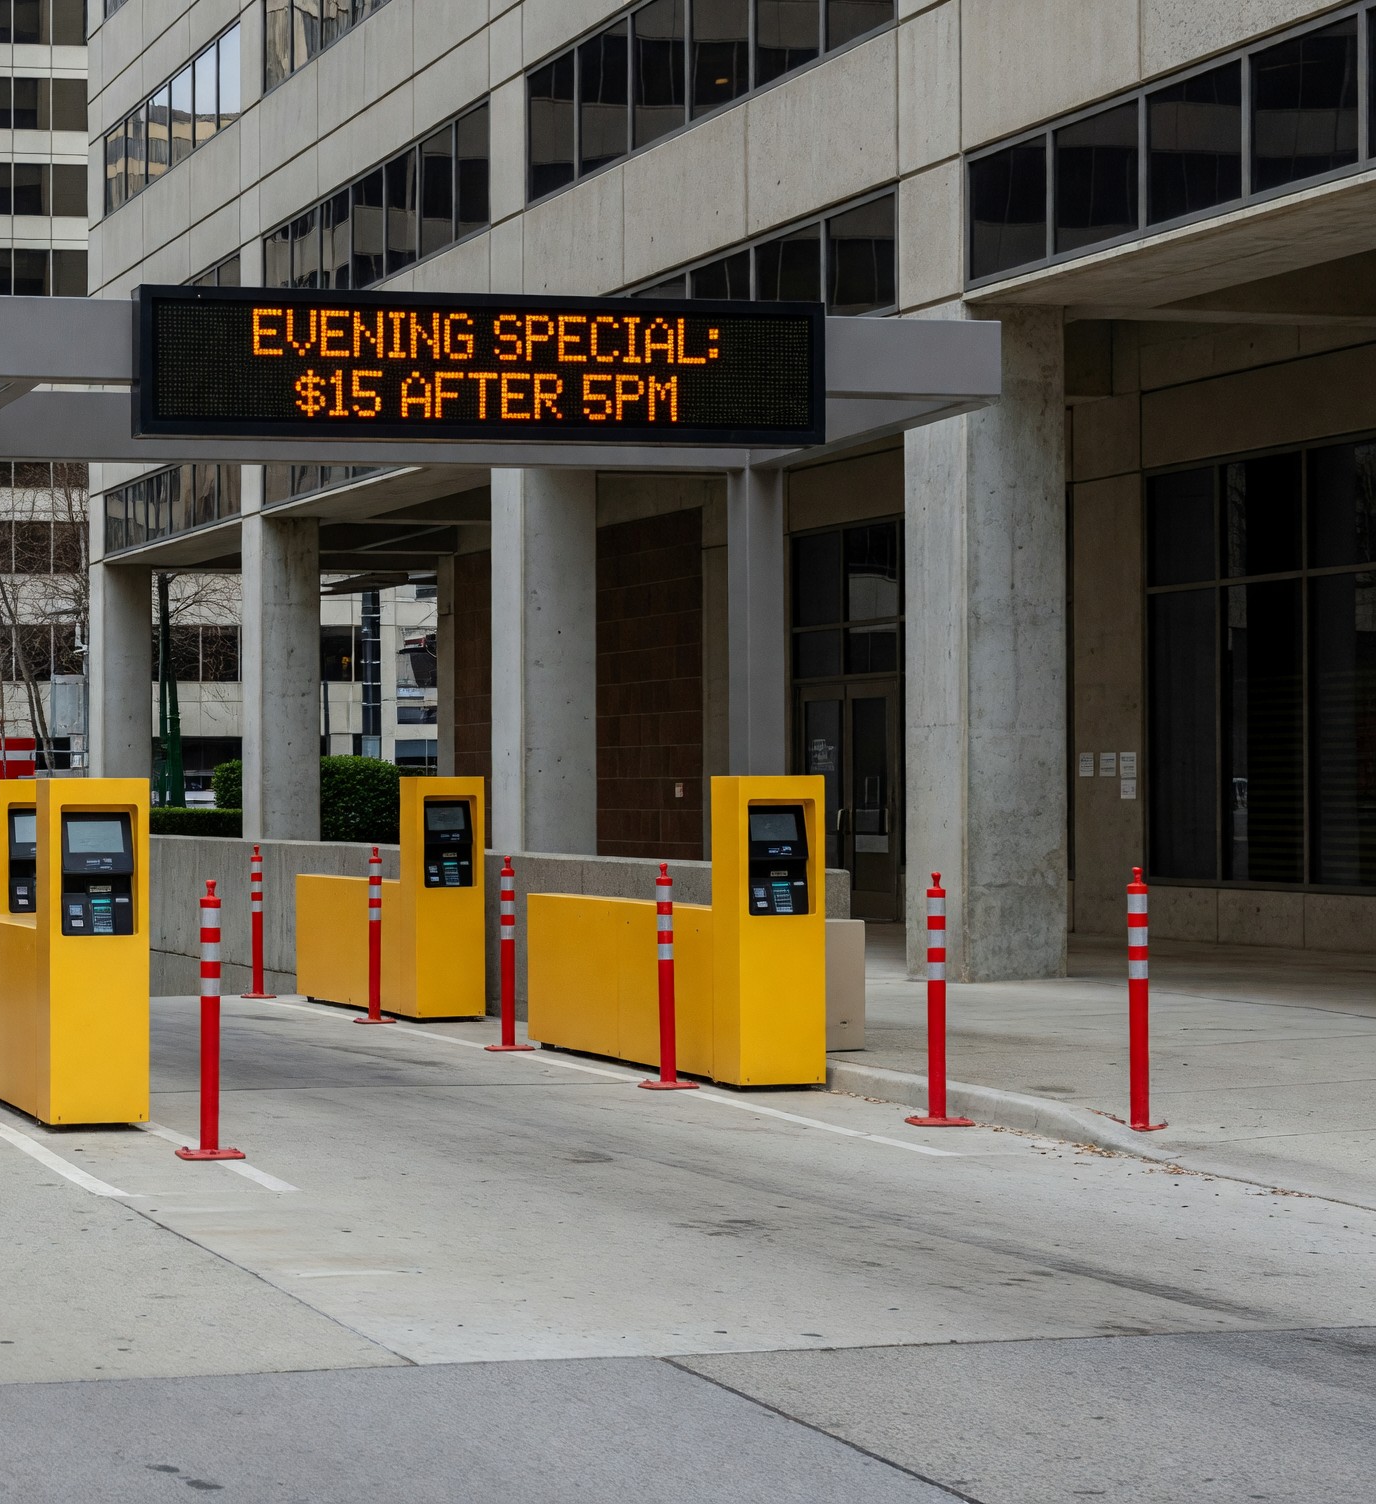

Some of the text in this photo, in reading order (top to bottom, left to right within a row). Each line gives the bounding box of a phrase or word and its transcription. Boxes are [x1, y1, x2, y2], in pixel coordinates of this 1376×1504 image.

[252, 308, 719, 365] EVENING SPECIAL:
[294, 369, 678, 422] $15 AFTER 5PM
